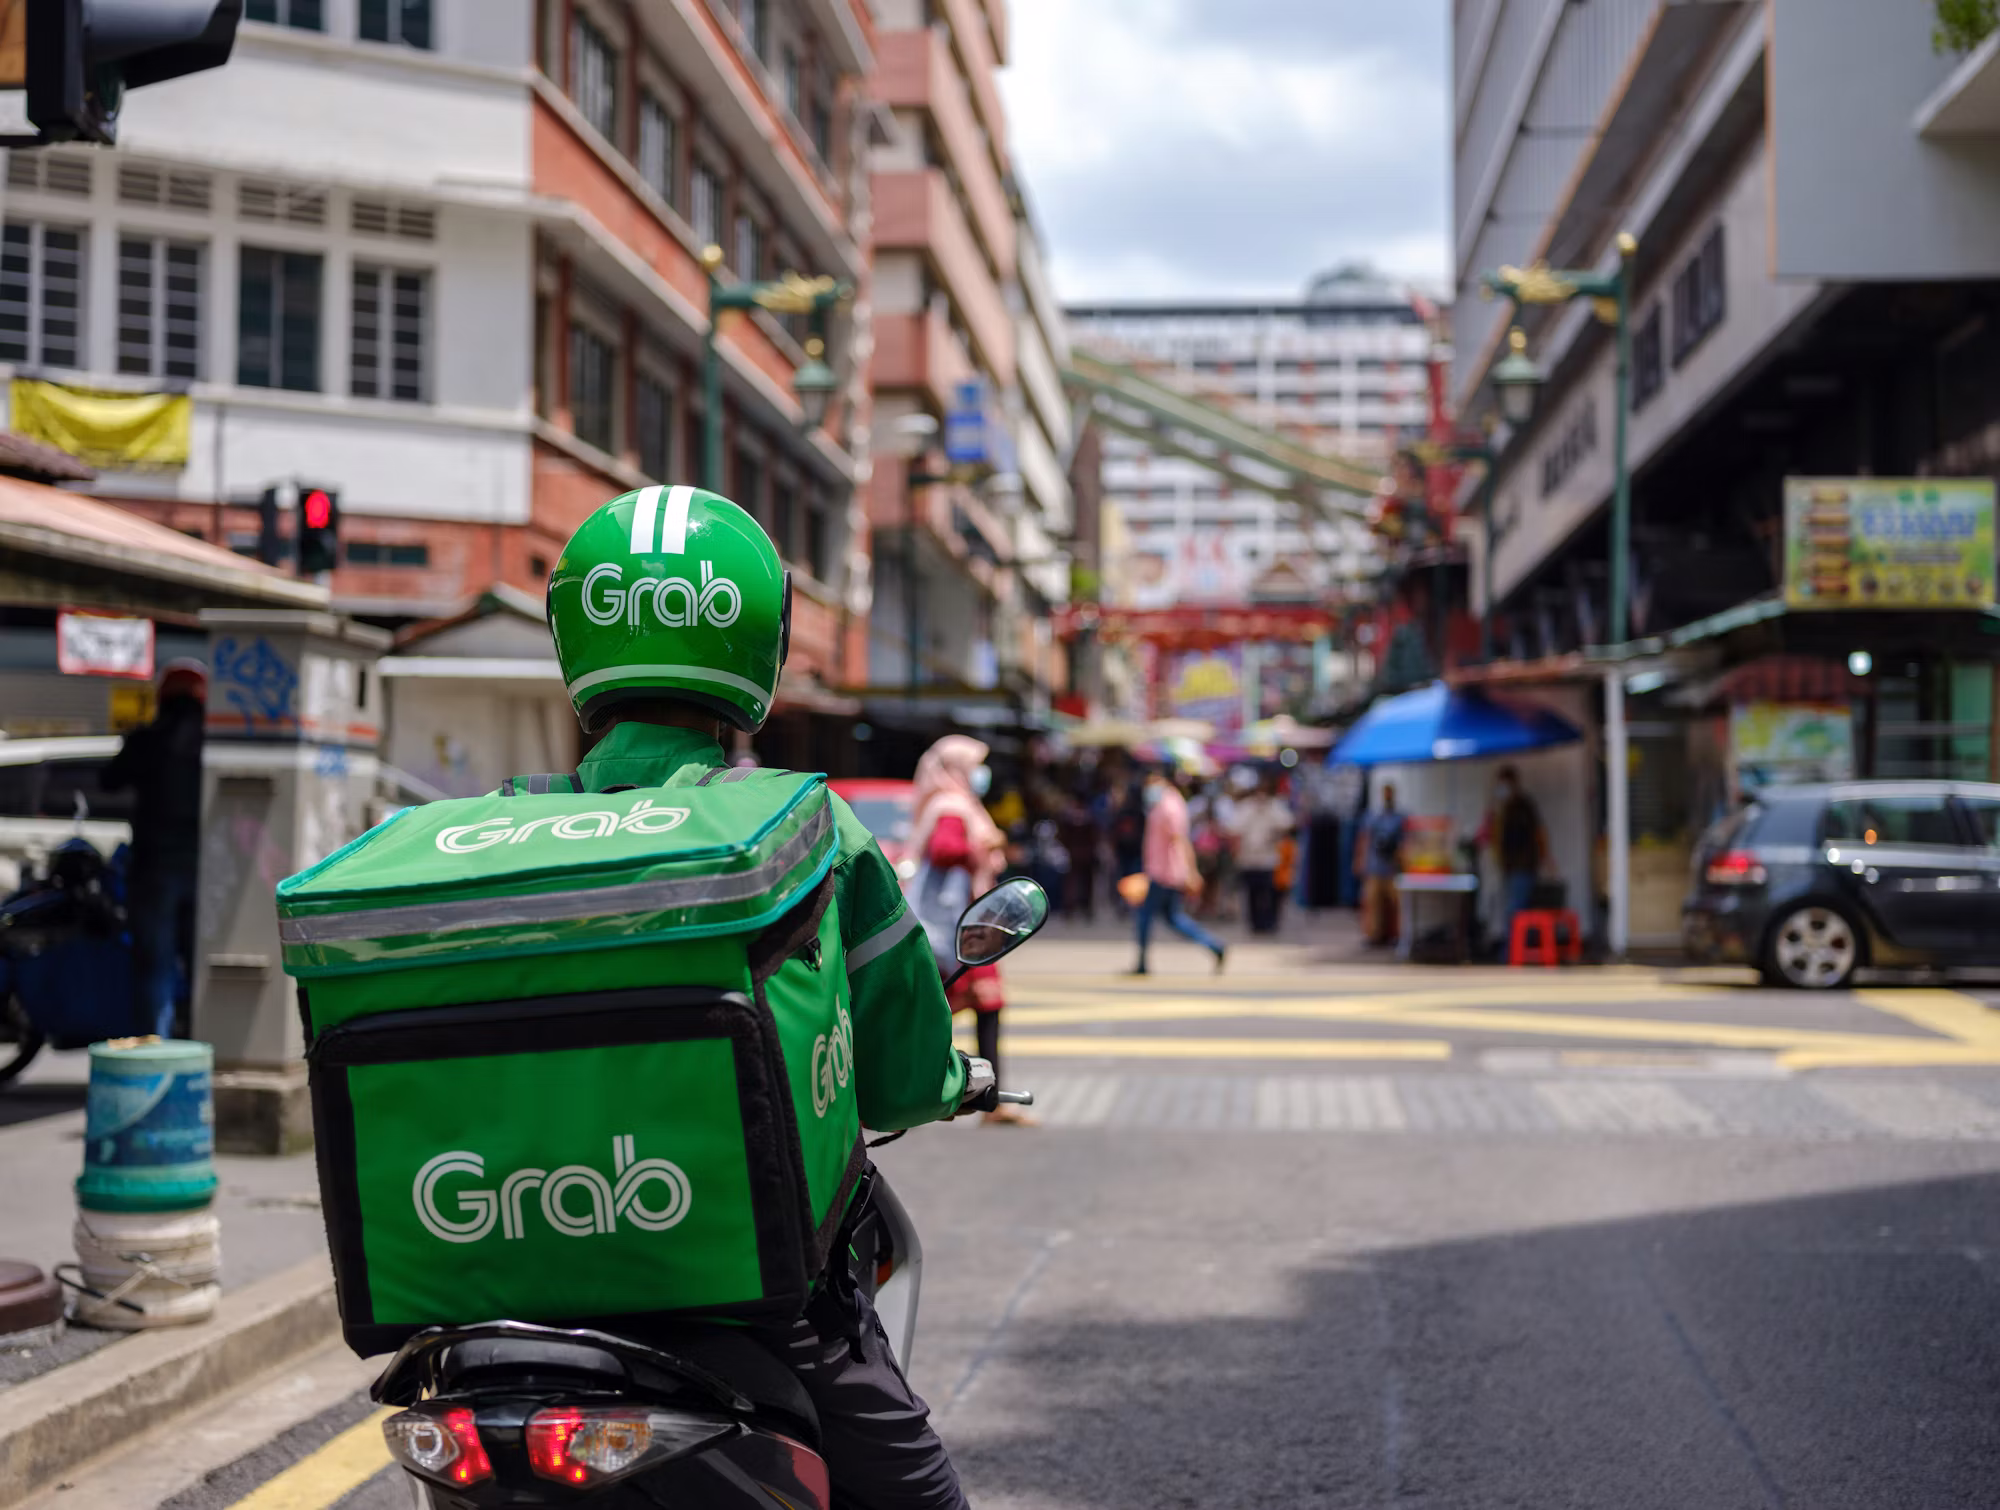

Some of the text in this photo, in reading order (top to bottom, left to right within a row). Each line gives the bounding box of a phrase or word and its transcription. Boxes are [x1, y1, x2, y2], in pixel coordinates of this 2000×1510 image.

[581, 560, 742, 628] Grab
[435, 799, 691, 854] Grab
[811, 992, 854, 1118] Grab
[412, 1134, 692, 1243] Grab
